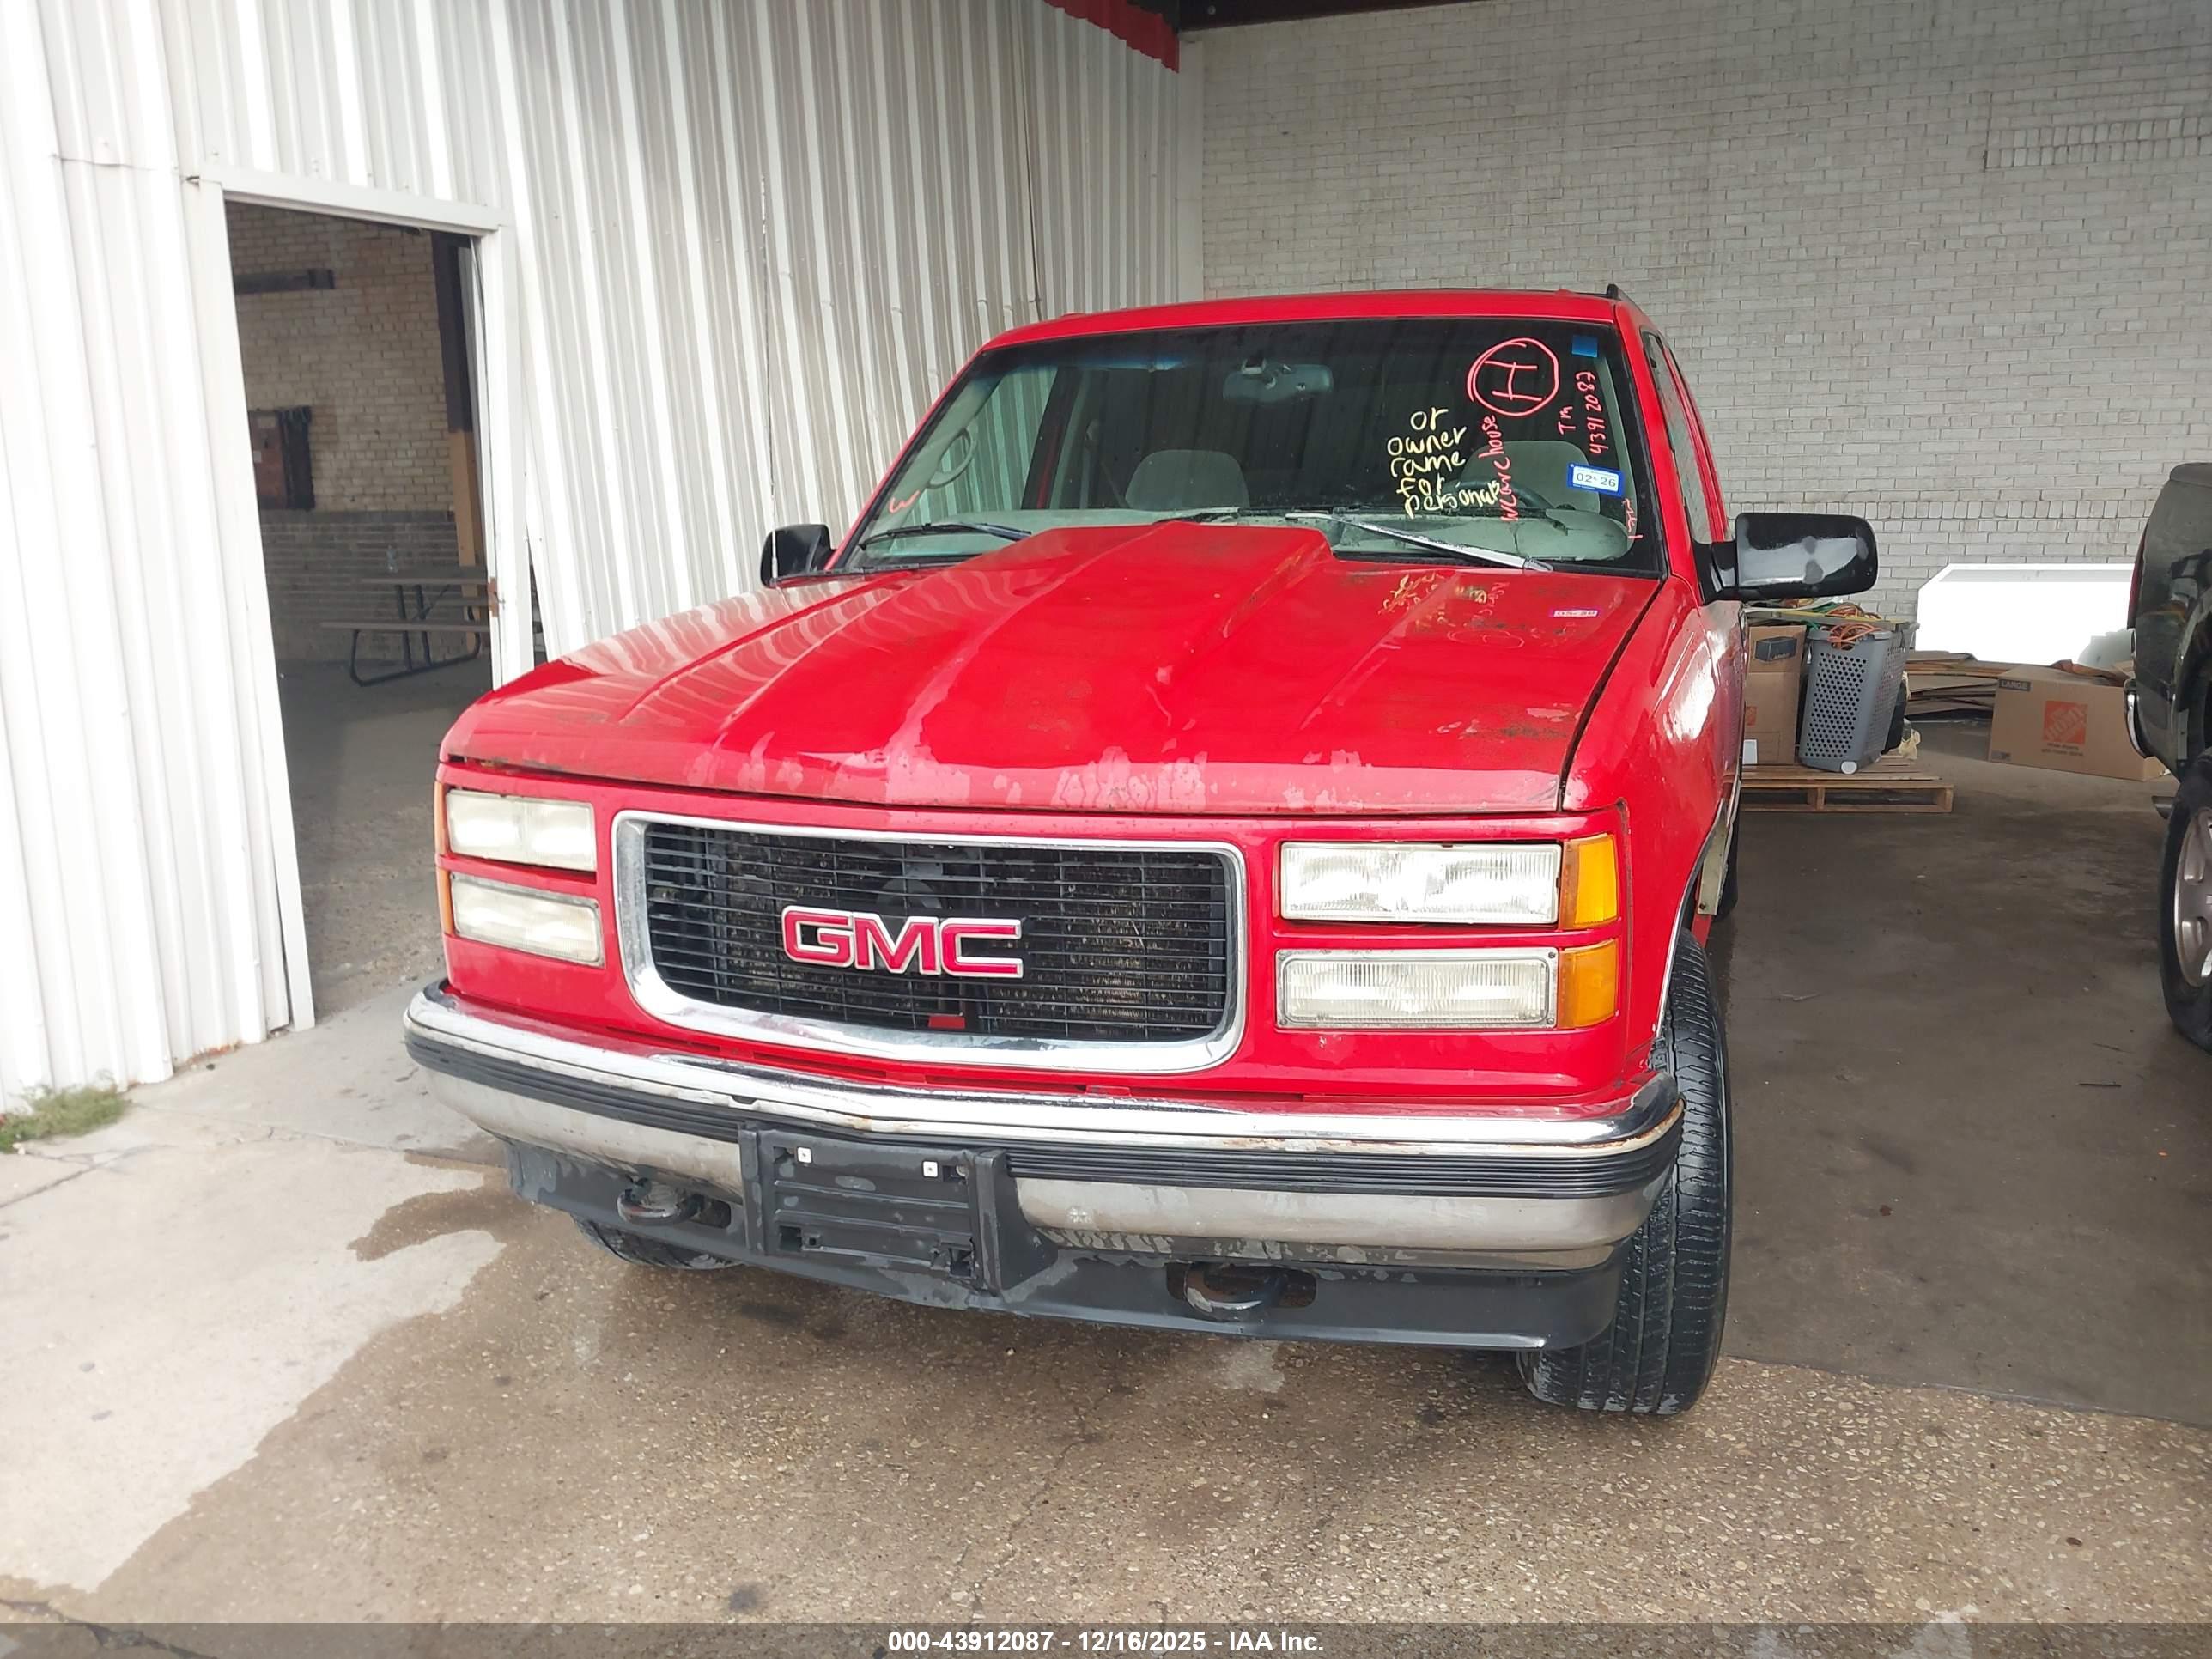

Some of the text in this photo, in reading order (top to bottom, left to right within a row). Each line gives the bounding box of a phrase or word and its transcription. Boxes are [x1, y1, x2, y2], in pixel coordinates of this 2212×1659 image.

[1410, 406, 1449, 432] or
[1387, 426, 1468, 456] owner
[1576, 472, 1593, 483] 02
[1600, 477, 1616, 488] 26
[781, 905, 1024, 979] GMC
